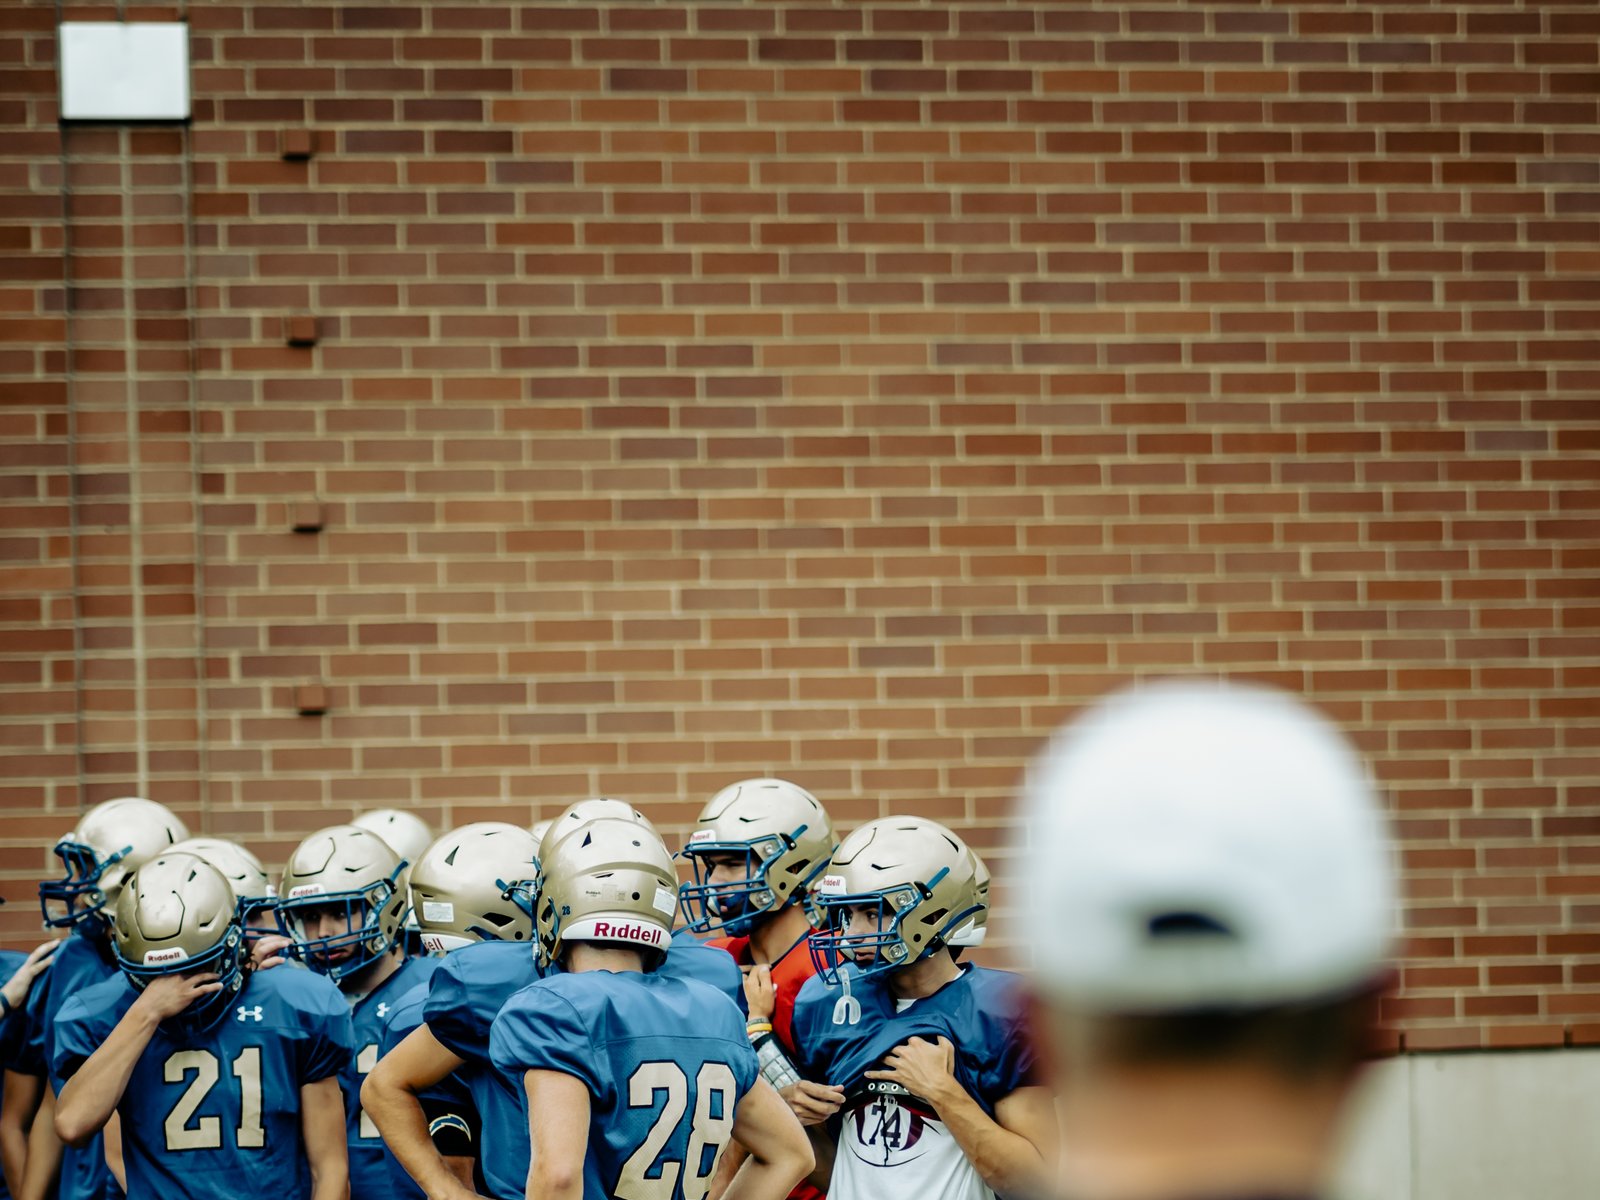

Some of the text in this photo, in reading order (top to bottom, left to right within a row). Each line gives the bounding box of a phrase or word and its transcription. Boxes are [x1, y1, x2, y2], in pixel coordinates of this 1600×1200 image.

[561, 905, 571, 916] 28
[593, 922, 662, 945] Riddell
[147, 951, 180, 962] Riddell
[163, 1046, 265, 1151] 21
[868, 1103, 901, 1148] 74
